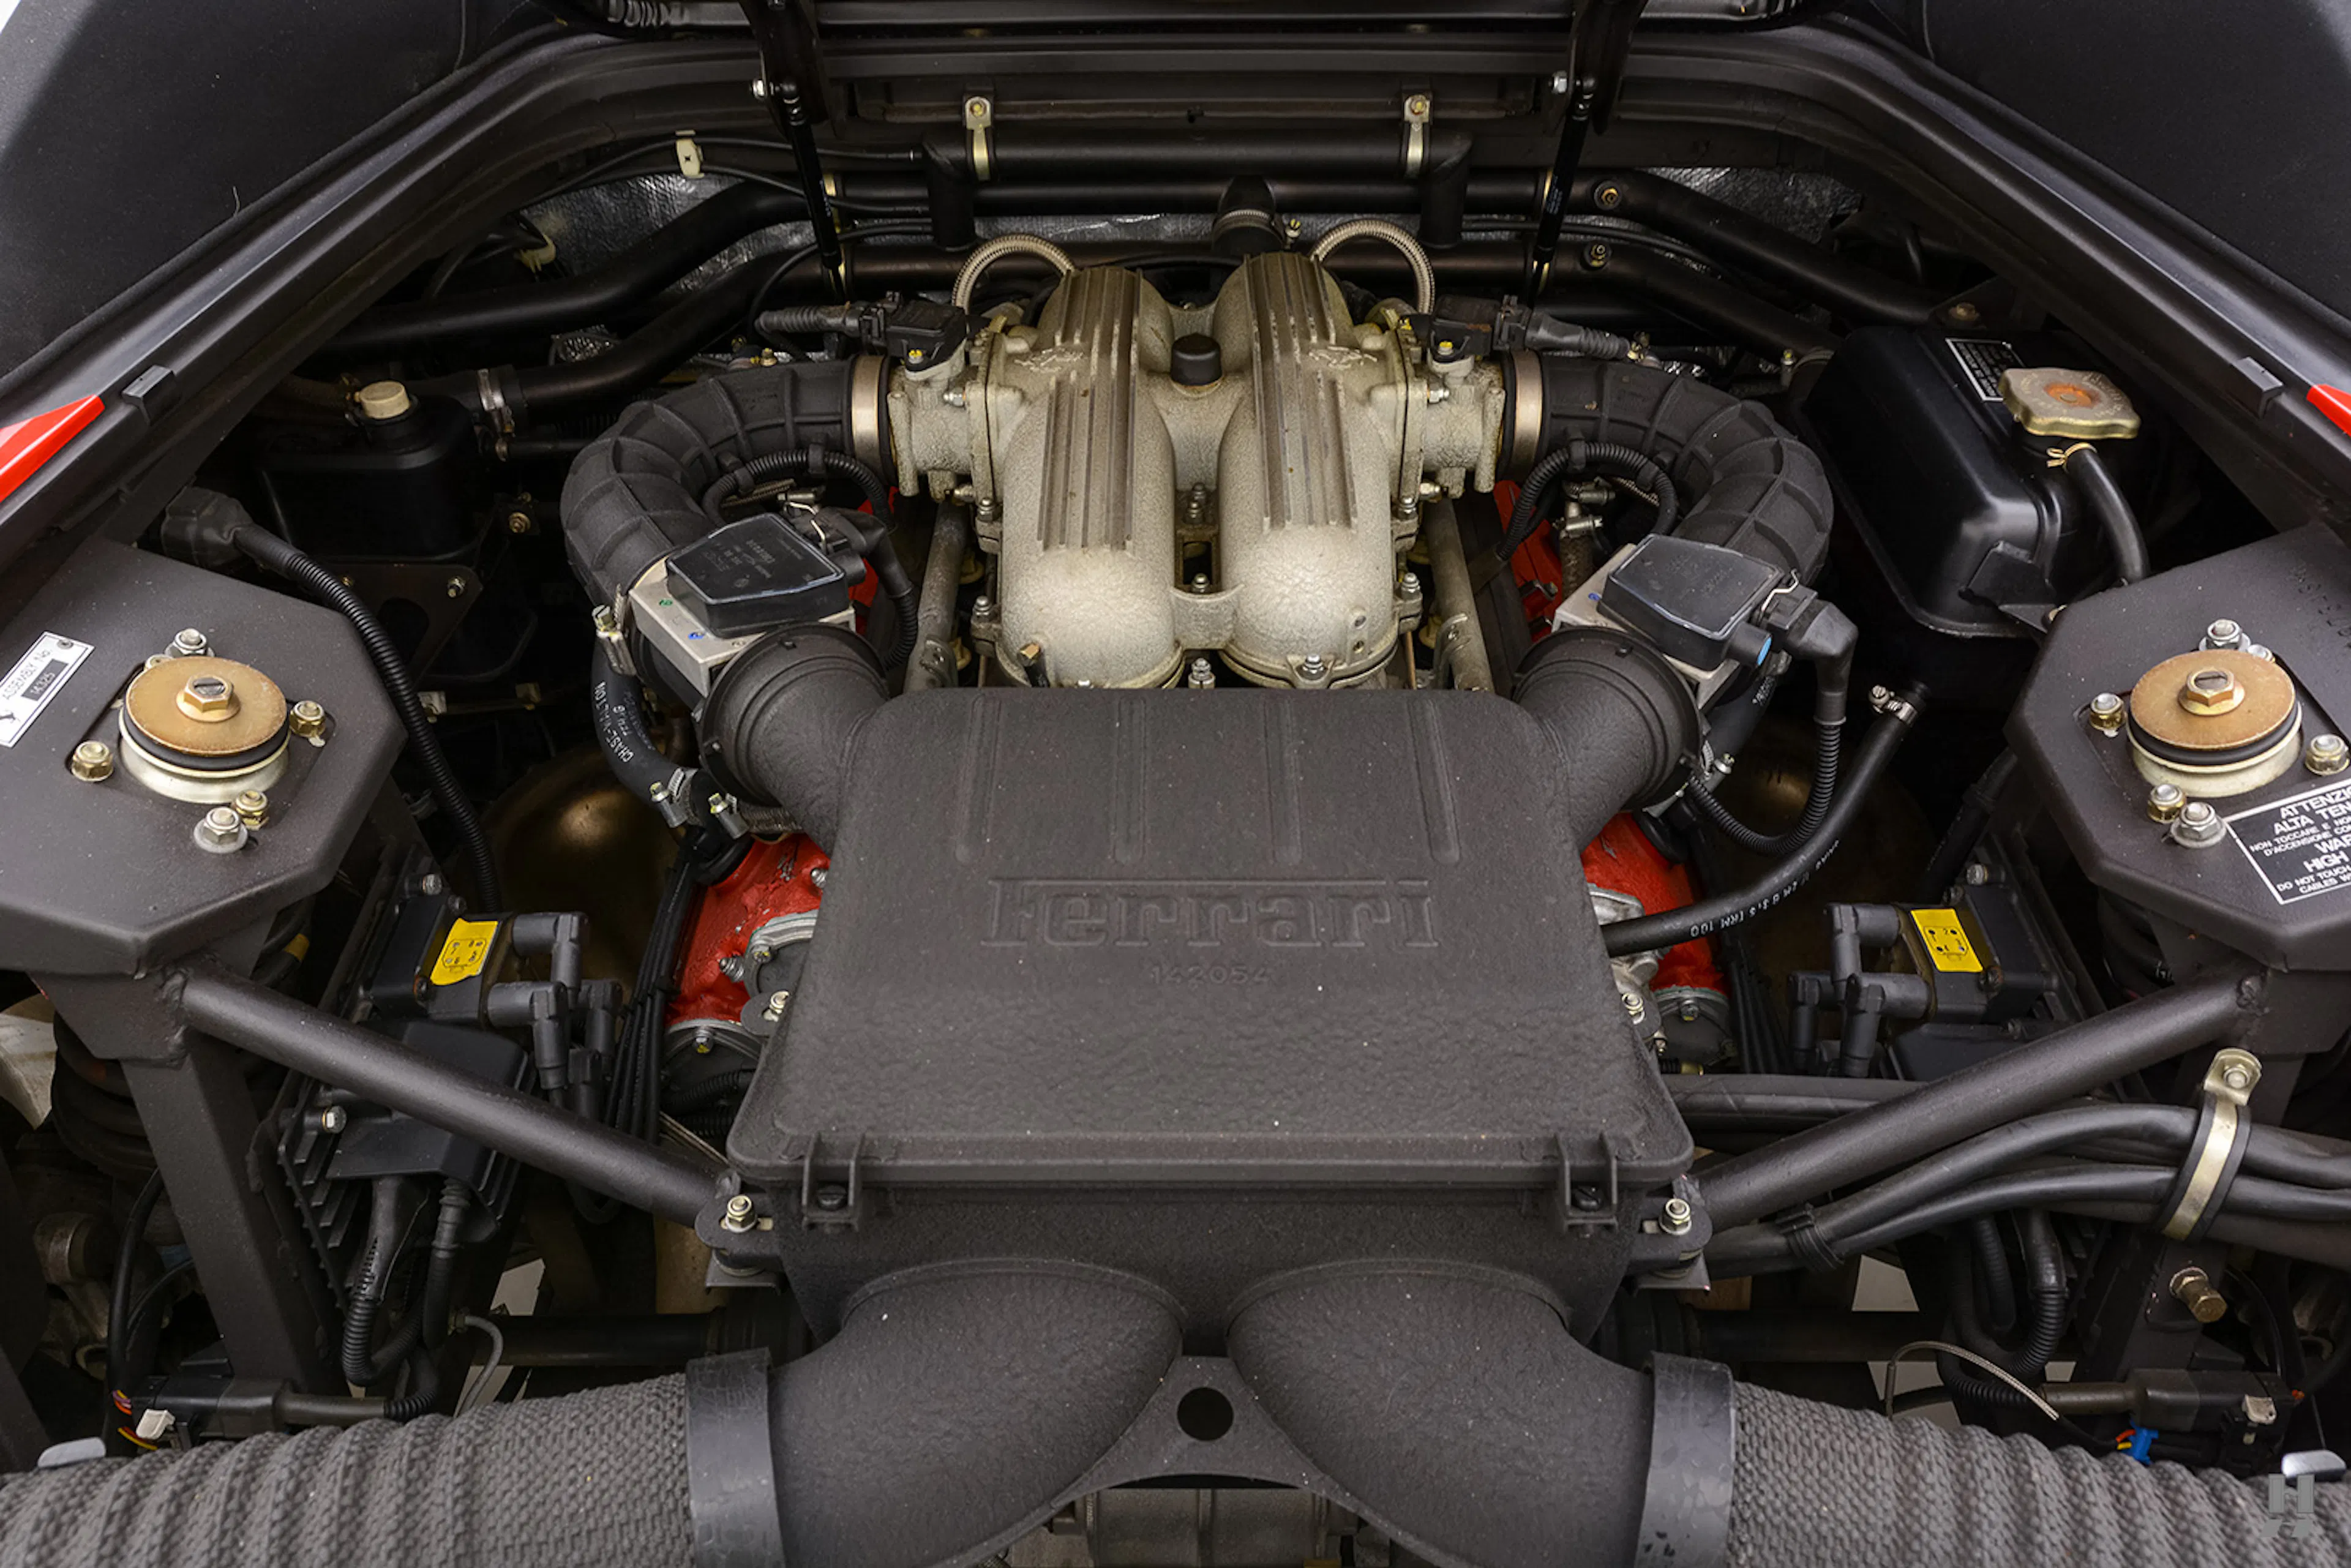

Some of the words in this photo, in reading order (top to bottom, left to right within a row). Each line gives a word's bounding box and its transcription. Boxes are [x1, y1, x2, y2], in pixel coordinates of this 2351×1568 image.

[2273, 814, 2315, 835] ALTA
[2249, 840, 2273, 852] NON
[2273, 825, 2320, 845] TOCCARE
[2303, 850, 2350, 873] HIGH
[2276, 880, 2293, 892] DO
[2294, 874, 2315, 887] NOT
[2298, 877, 2339, 894] CABLES
[979, 877, 1440, 947] Ferrari
